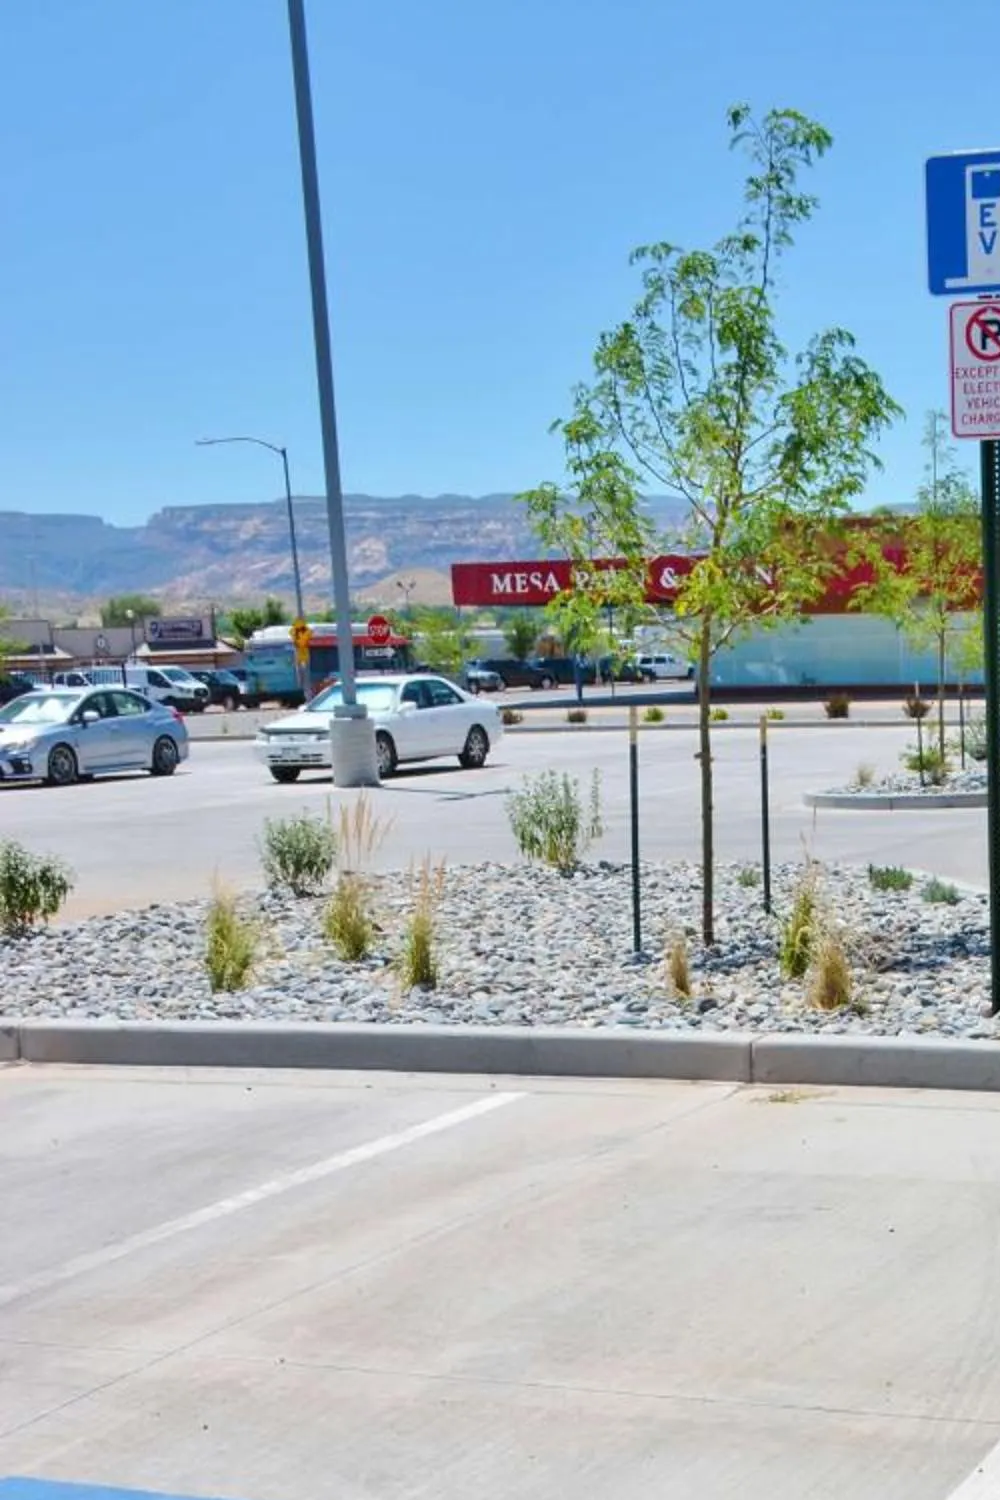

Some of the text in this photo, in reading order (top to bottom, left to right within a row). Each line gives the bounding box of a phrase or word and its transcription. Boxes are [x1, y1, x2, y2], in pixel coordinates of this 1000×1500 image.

[978, 203, 997, 255] EV
[955, 366, 999, 379] EXCEPT
[489, 571, 560, 594] MESA
